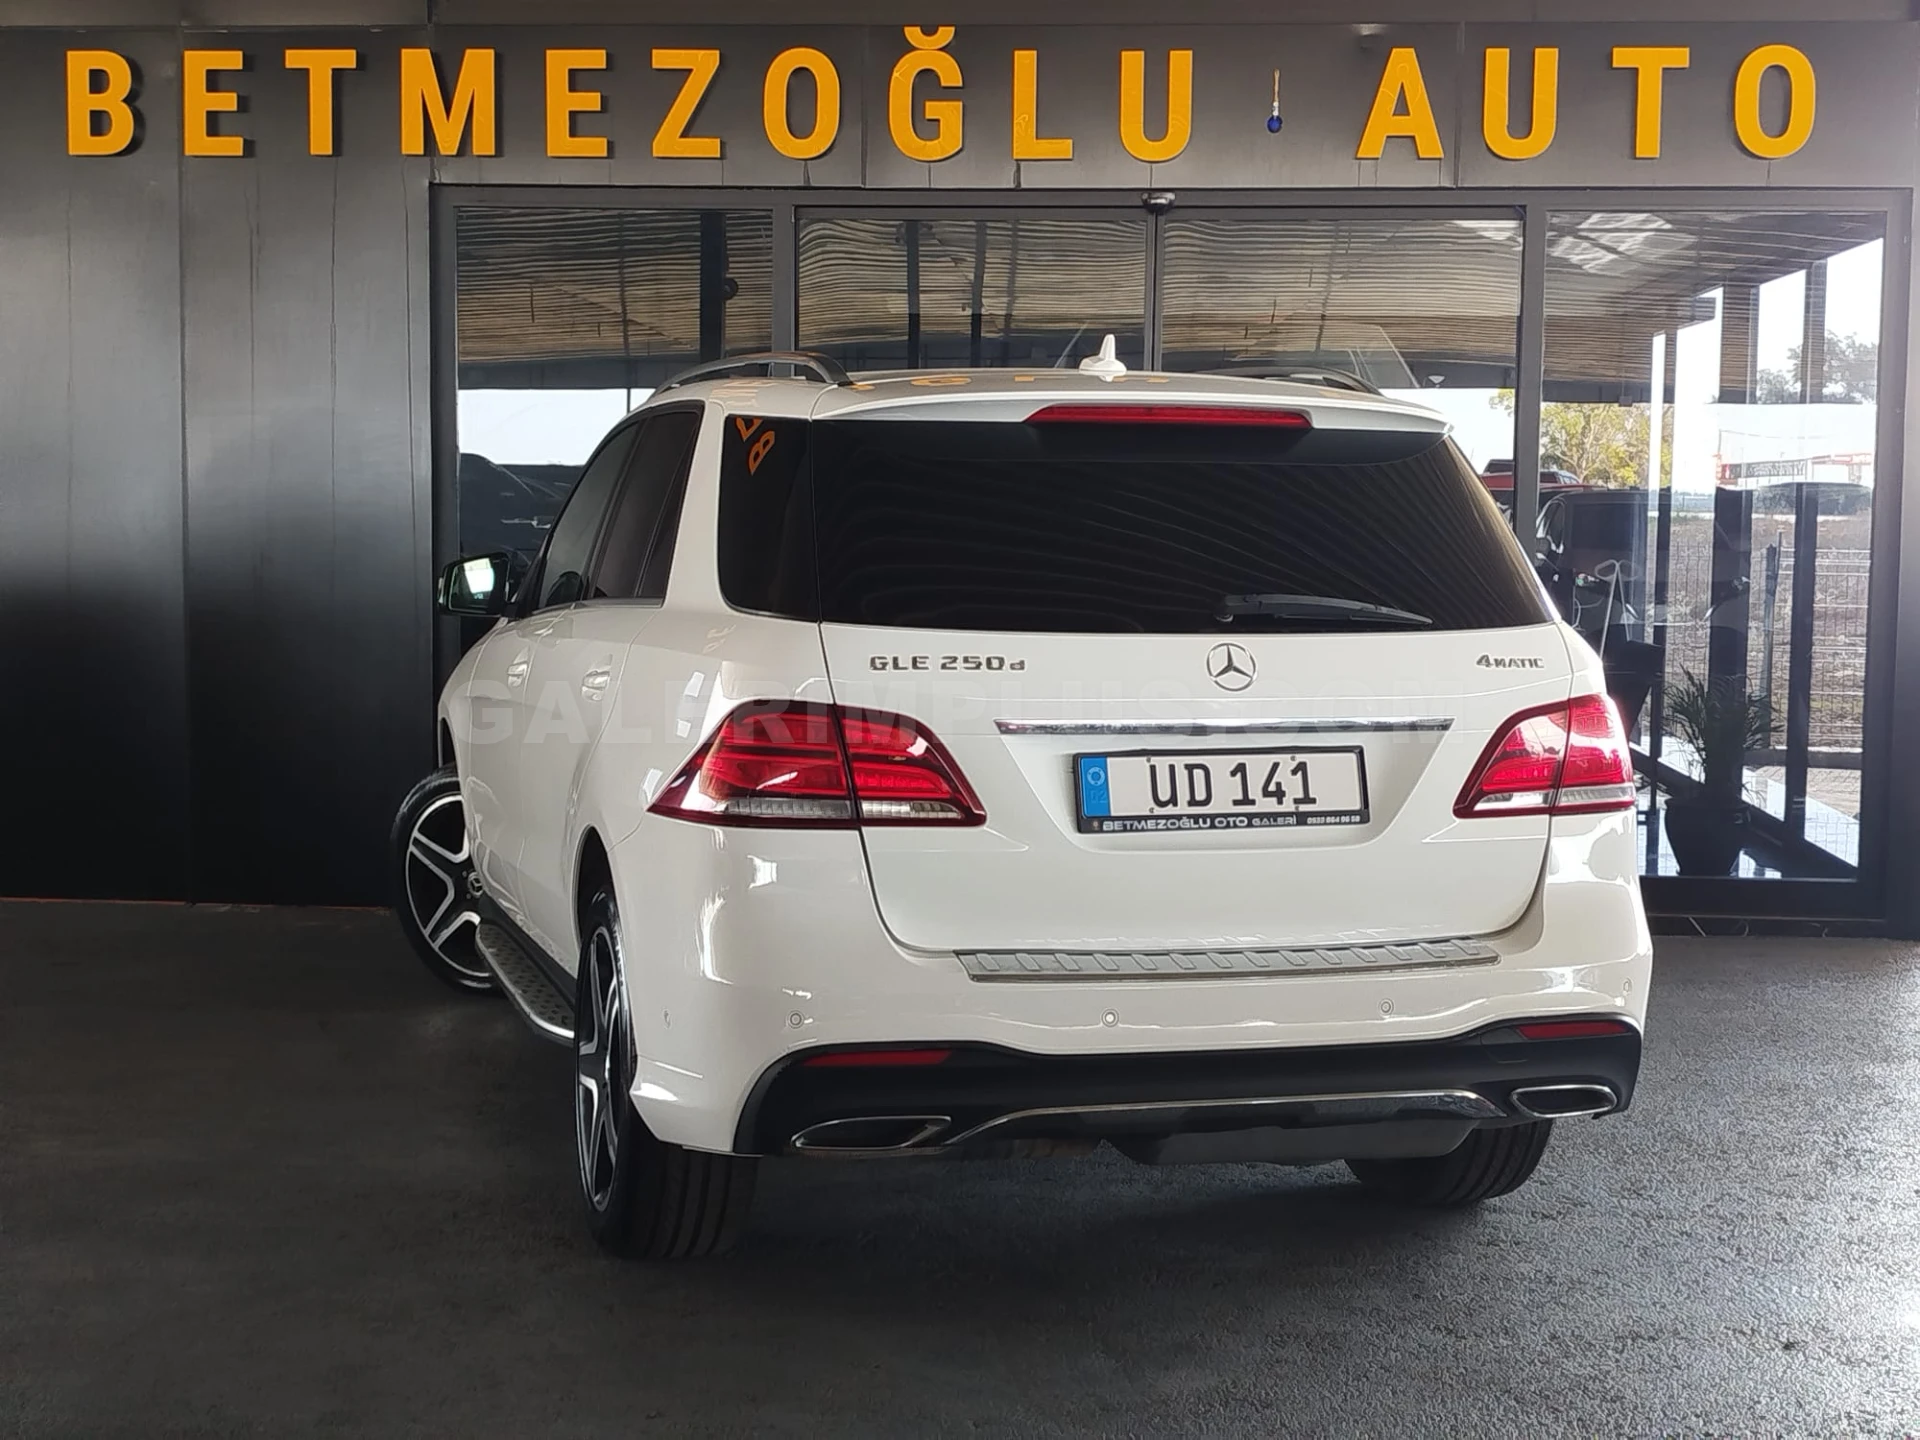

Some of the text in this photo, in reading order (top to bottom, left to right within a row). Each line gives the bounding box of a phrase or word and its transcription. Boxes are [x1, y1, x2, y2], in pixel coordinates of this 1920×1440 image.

[66, 26, 1816, 162] BETMEZOĞLU AUTO
[869, 655, 1025, 671] GLE 250d
[1475, 654, 1545, 669] 4MATIC
[1149, 761, 1317, 808] UD 141
[1102, 815, 1211, 832] BETMEZOĞLU
[1214, 816, 1249, 828] OTO
